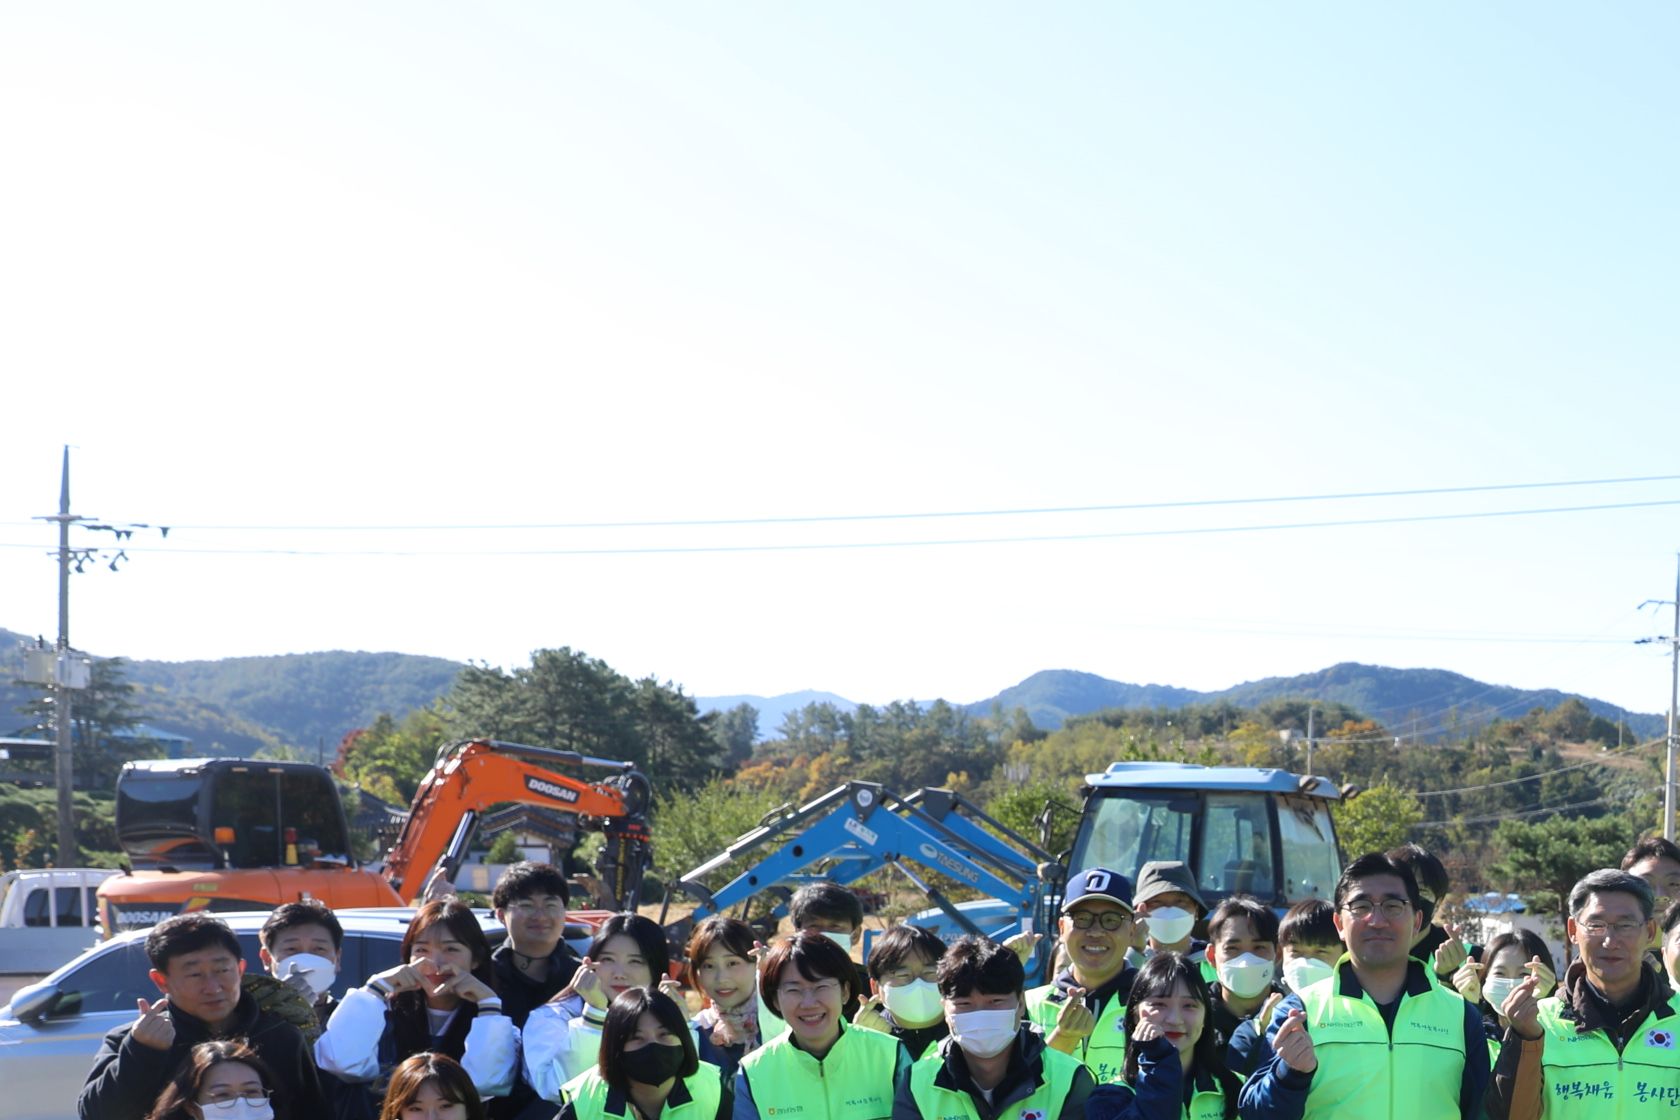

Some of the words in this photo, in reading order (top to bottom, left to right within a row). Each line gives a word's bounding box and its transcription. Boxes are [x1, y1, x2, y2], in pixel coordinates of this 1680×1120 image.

[528, 778, 578, 802] DOOSAN
[1555, 1081, 1615, 1101] 행복채움
[1633, 1081, 1680, 1107] 봉사단
